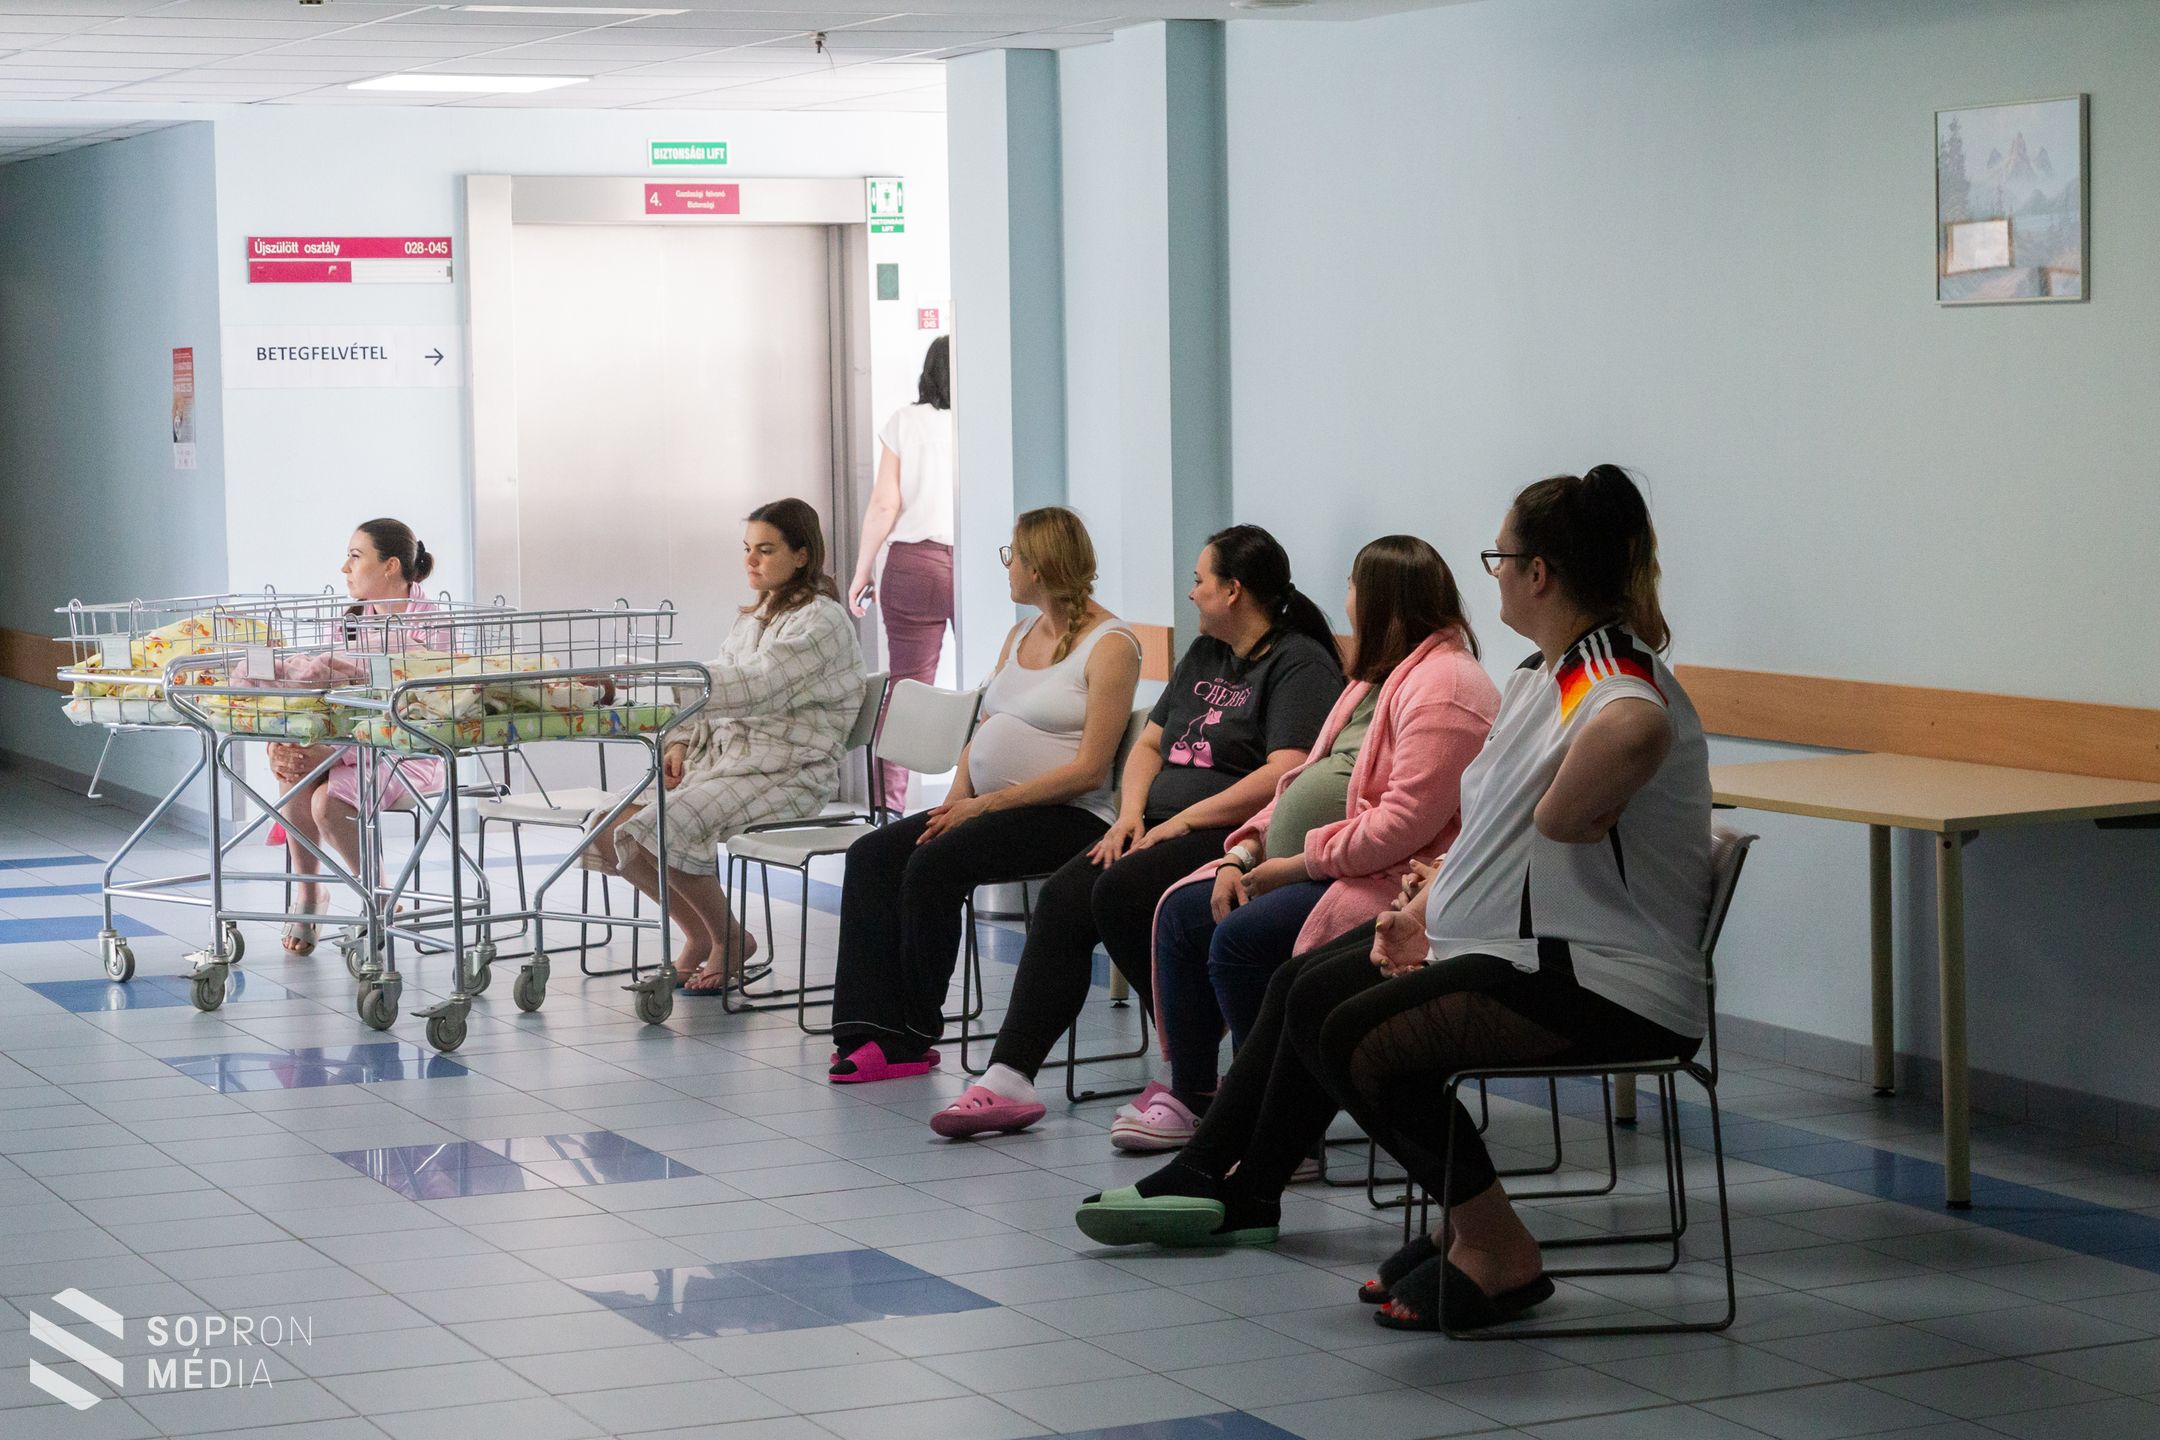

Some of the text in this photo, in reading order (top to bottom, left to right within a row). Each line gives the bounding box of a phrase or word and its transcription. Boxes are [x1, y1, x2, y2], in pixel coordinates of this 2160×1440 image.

[653, 145, 725, 160] BIZTONSÁGI LIFT
[649, 191, 662, 206] 4.
[254, 238, 448, 255] Újszülött osztály 028-045
[256, 342, 389, 361] BETEGFELVÉTEL
